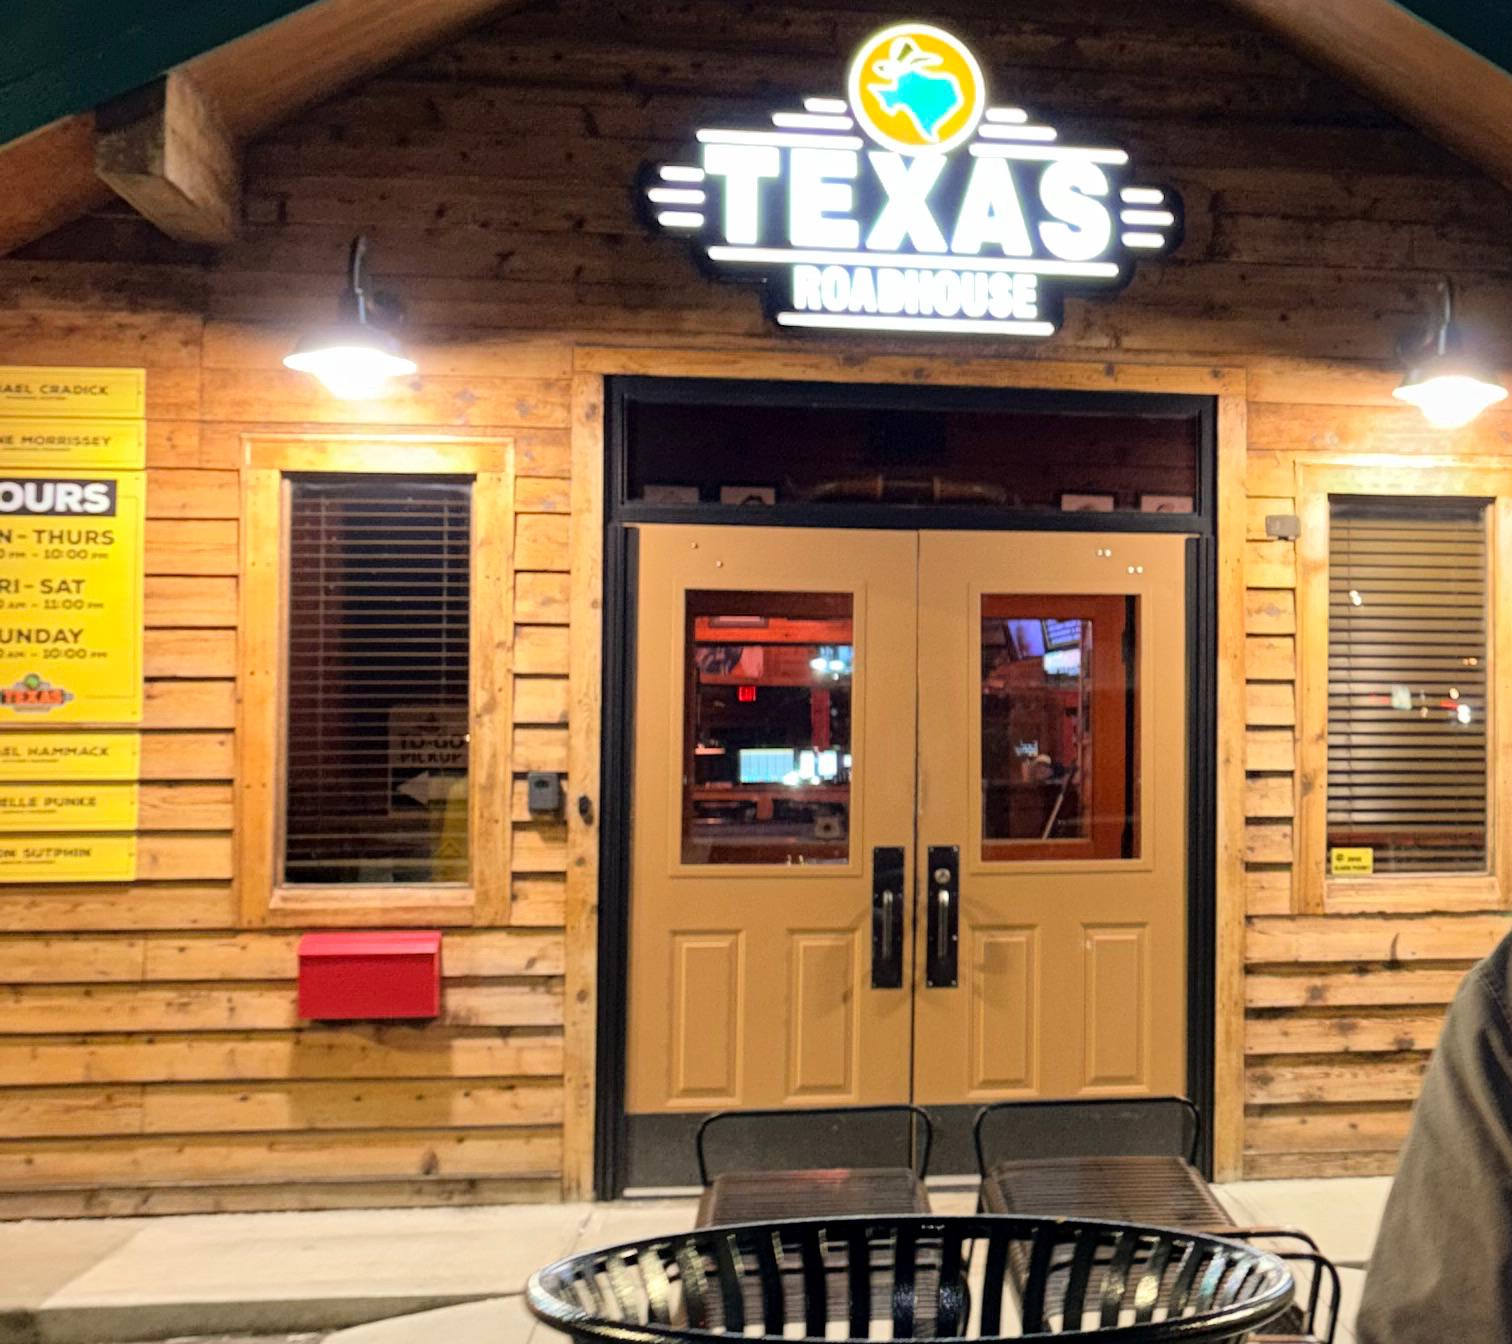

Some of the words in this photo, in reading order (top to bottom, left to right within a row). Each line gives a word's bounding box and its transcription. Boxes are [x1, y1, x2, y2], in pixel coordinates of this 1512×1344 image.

[703, 144, 1113, 262] TEXAS
[792, 265, 1038, 320] ROADHOUSE
[0, 383, 33, 394] AEL
[0, 481, 111, 513] OURS
[32, 529, 115, 545] THURS
[44, 548, 88, 560] 10:00
[0, 578, 20, 594] RI
[40, 578, 86, 595] SAT
[0, 628, 84, 644] UNDAY
[43, 648, 87, 660] 10:00
[0, 796, 37, 807] ELLE
